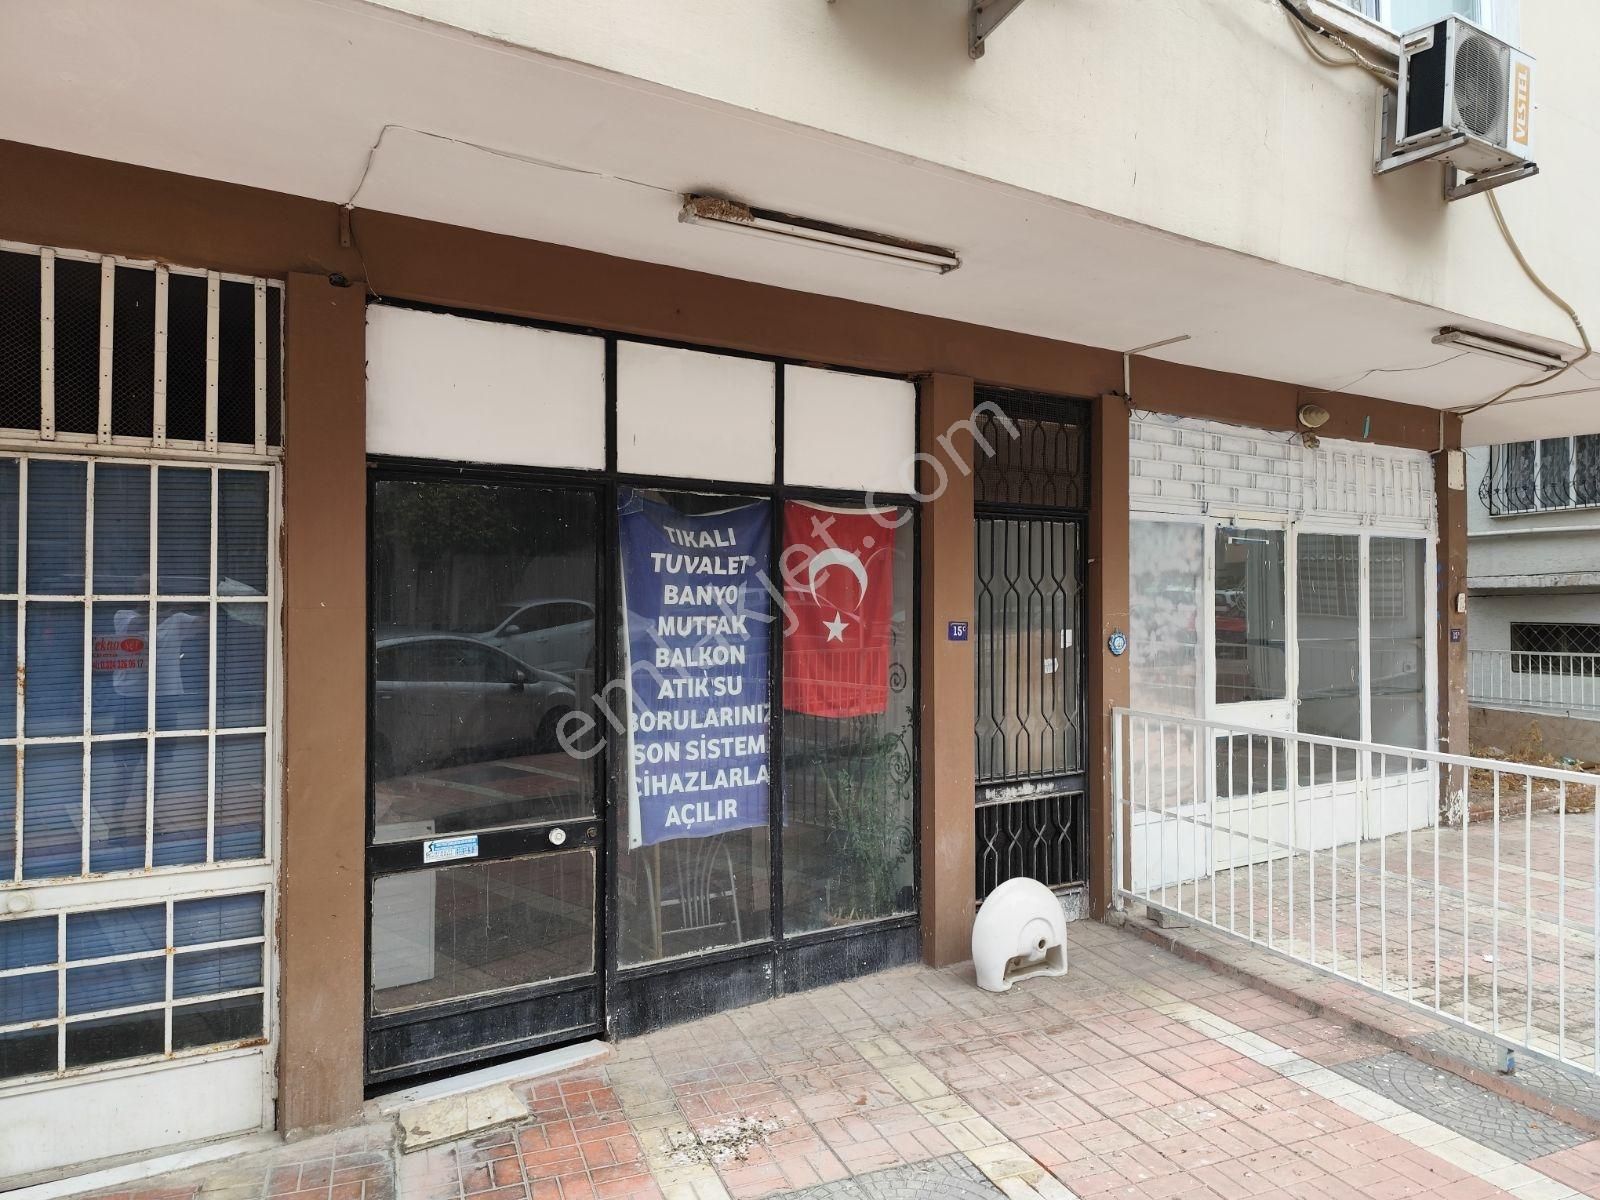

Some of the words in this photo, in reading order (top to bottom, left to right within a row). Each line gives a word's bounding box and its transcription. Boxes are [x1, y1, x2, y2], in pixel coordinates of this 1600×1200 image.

[1516, 69, 1528, 138] VESTEL
[664, 525, 735, 548] TIKALI
[651, 552, 749, 575] TUVALET
[664, 585, 737, 606] BANYO
[657, 615, 748, 637] MUTFAK
[655, 645, 745, 668] BALKON
[657, 675, 707, 700] ATIK
[710, 676, 743, 697] SU
[634, 741, 680, 765] SON
[685, 734, 765, 761] SİSTEM
[665, 799, 737, 829] AÇILIR
